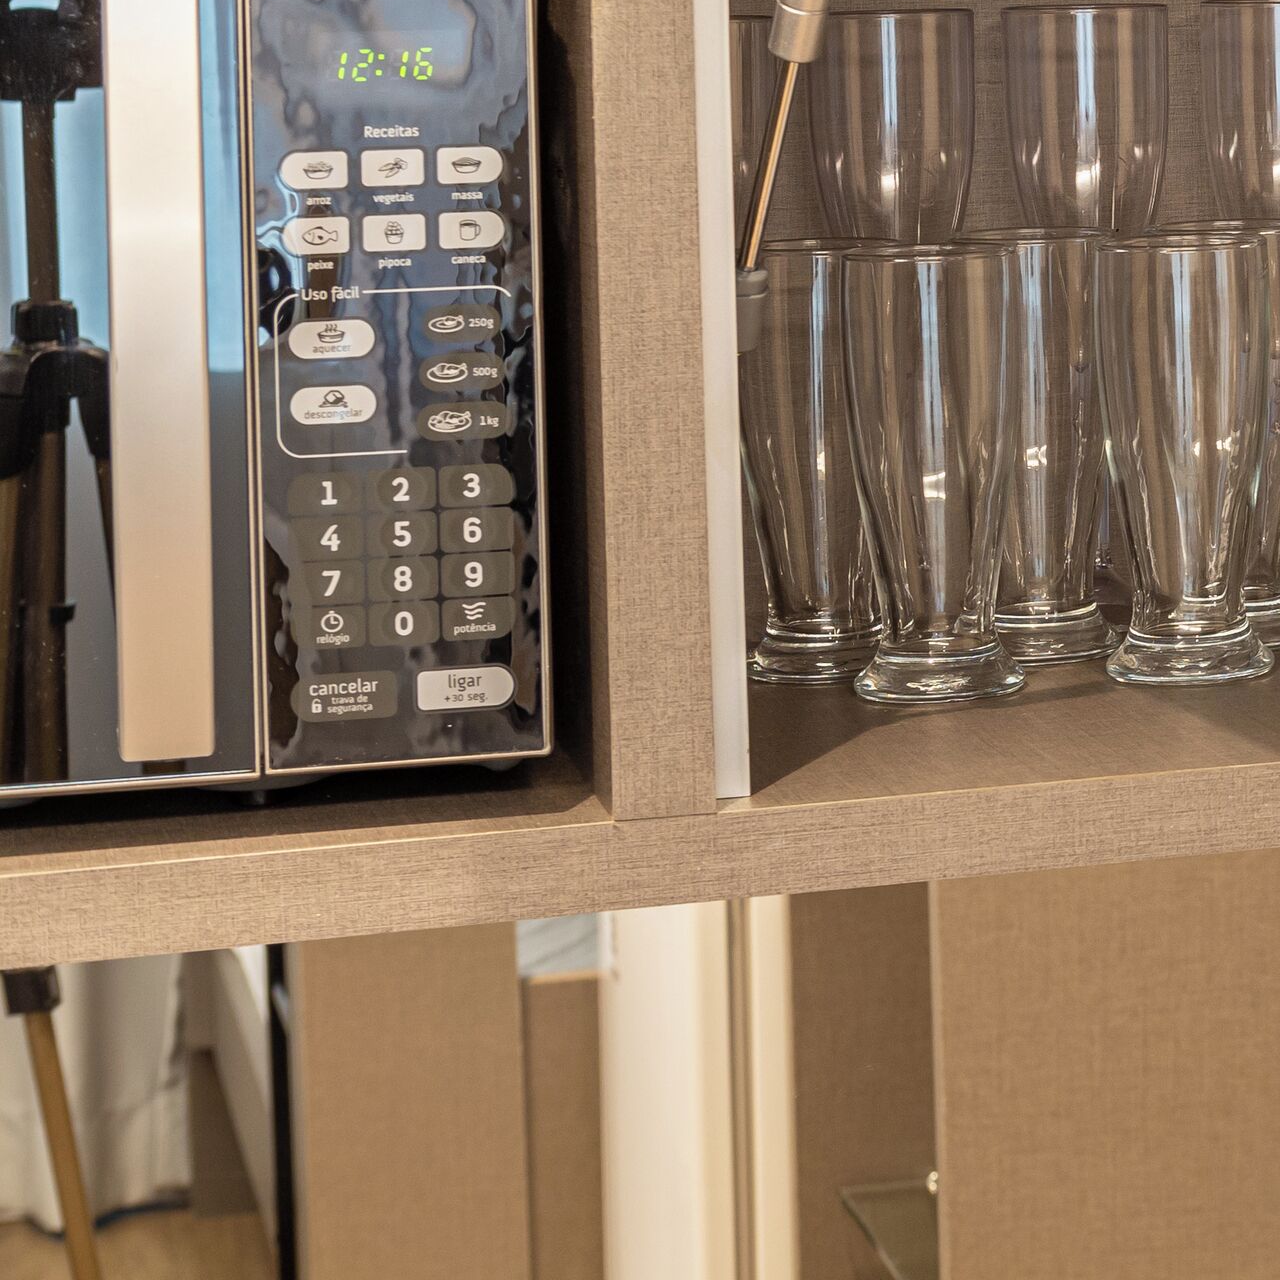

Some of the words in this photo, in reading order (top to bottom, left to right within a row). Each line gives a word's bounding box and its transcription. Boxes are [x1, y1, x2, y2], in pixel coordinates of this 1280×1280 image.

[338, 47, 433, 82] 12:16
[364, 124, 420, 138] Receitas
[306, 196, 332, 206] arroz
[373, 192, 414, 204] vegetais
[452, 190, 483, 201] massa
[307, 260, 334, 272] peixe
[378, 257, 412, 270] pipoca
[452, 254, 486, 265] caneca
[302, 288, 328, 301] Uso
[331, 286, 360, 303] fácil
[468, 318, 494, 329] 250g
[312, 344, 351, 355] aquecer
[472, 366, 498, 378] 500g
[304, 407, 363, 421] descongelar
[392, 477, 410, 502] 2
[462, 473, 481, 498] 3
[320, 481, 338, 506] 1
[392, 520, 412, 547] 5
[463, 517, 482, 543] 6
[320, 524, 341, 552] 4
[394, 566, 412, 592] 8
[464, 562, 483, 588] 9
[322, 570, 341, 596] 7
[394, 611, 414, 636] 0
[454, 622, 496, 636] potência
[316, 633, 350, 646] relógio
[309, 678, 378, 696] cancelar
[448, 673, 482, 692] ligar
[332, 695, 355, 705] trava
[357, 694, 368, 704] de
[468, 692, 488, 704] seg.
[327, 702, 374, 715] segurança
